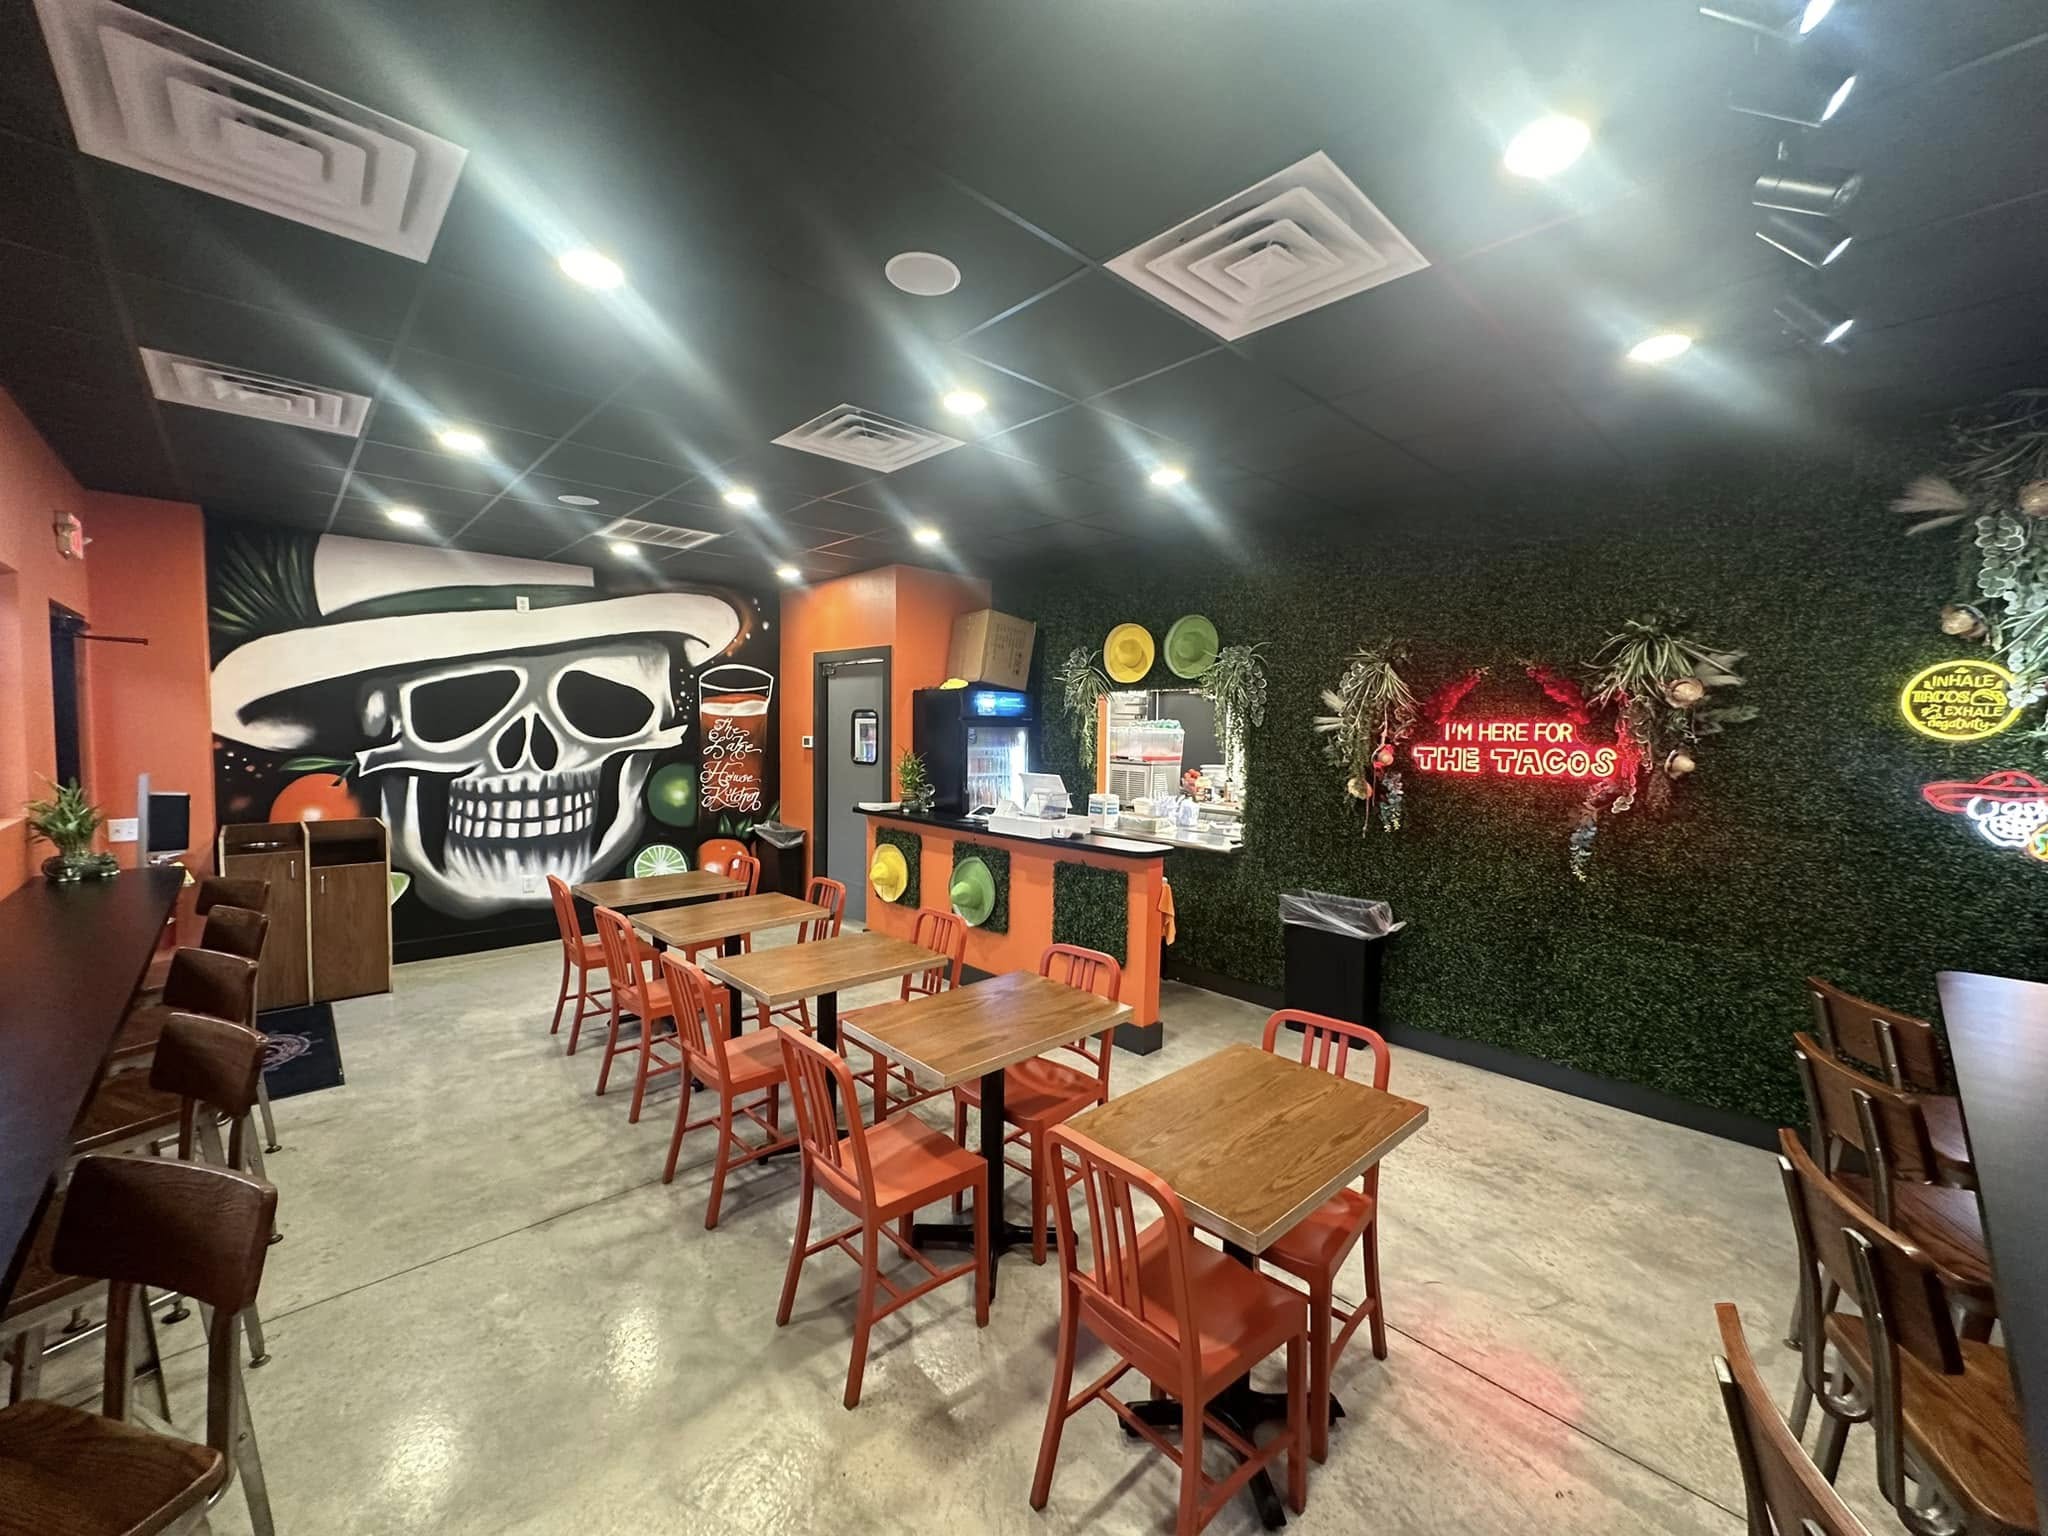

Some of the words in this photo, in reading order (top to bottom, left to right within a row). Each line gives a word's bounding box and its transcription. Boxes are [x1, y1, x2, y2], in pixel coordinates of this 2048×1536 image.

[1932, 674, 1996, 688] INHALE
[1911, 690, 1971, 704] TACOS
[1944, 704, 2005, 718] EXHALE
[713, 718, 750, 740] The
[1444, 722, 1473, 742] I'M
[1478, 722, 1530, 743] HERE
[1534, 722, 1573, 743] FOR
[703, 729, 762, 761] Lake
[1413, 746, 1480, 773] THE
[1490, 746, 1618, 777] TACOS
[701, 784, 762, 812] Kitchen
